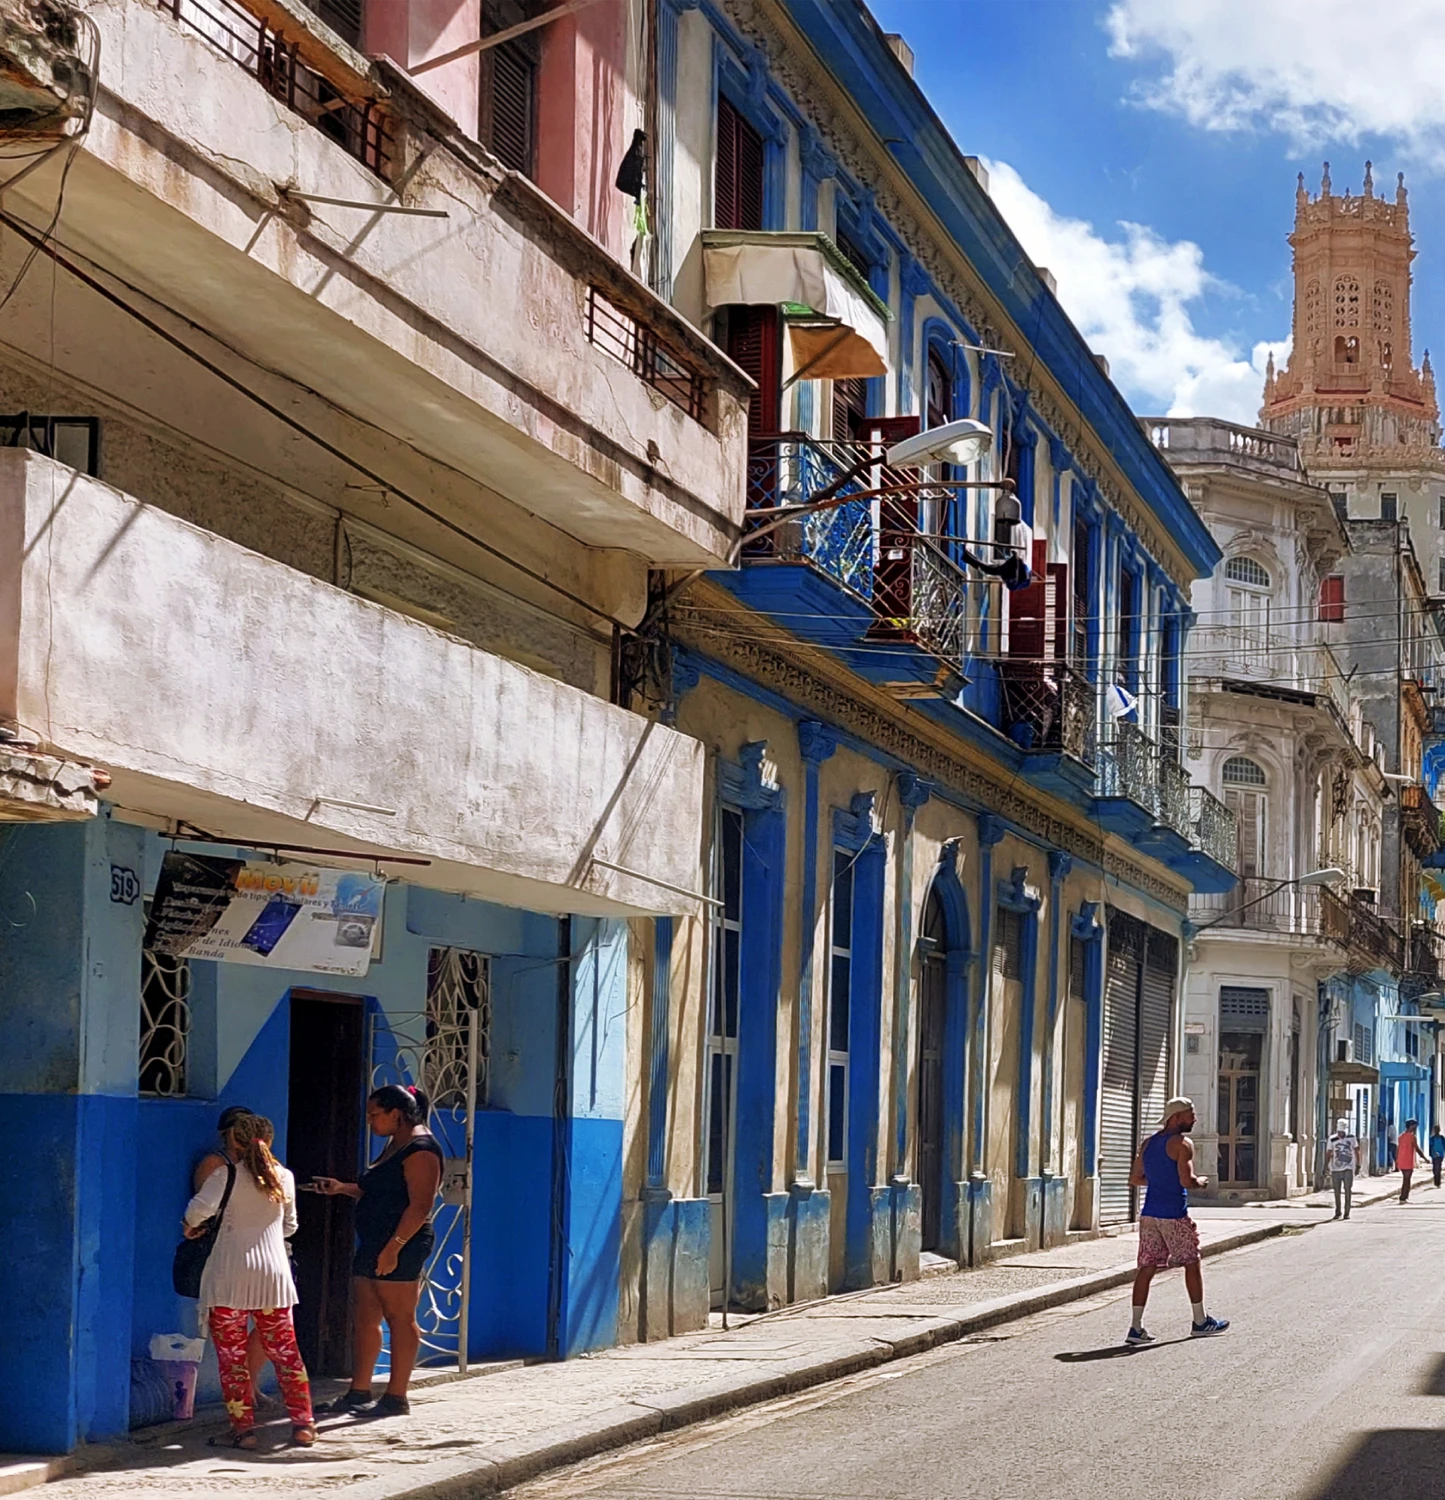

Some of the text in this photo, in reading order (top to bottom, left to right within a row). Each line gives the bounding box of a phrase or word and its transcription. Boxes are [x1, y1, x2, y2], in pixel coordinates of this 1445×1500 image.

[112, 873, 133, 898] 519
[250, 892, 269, 902] tipo
[189, 946, 225, 959] Banda
